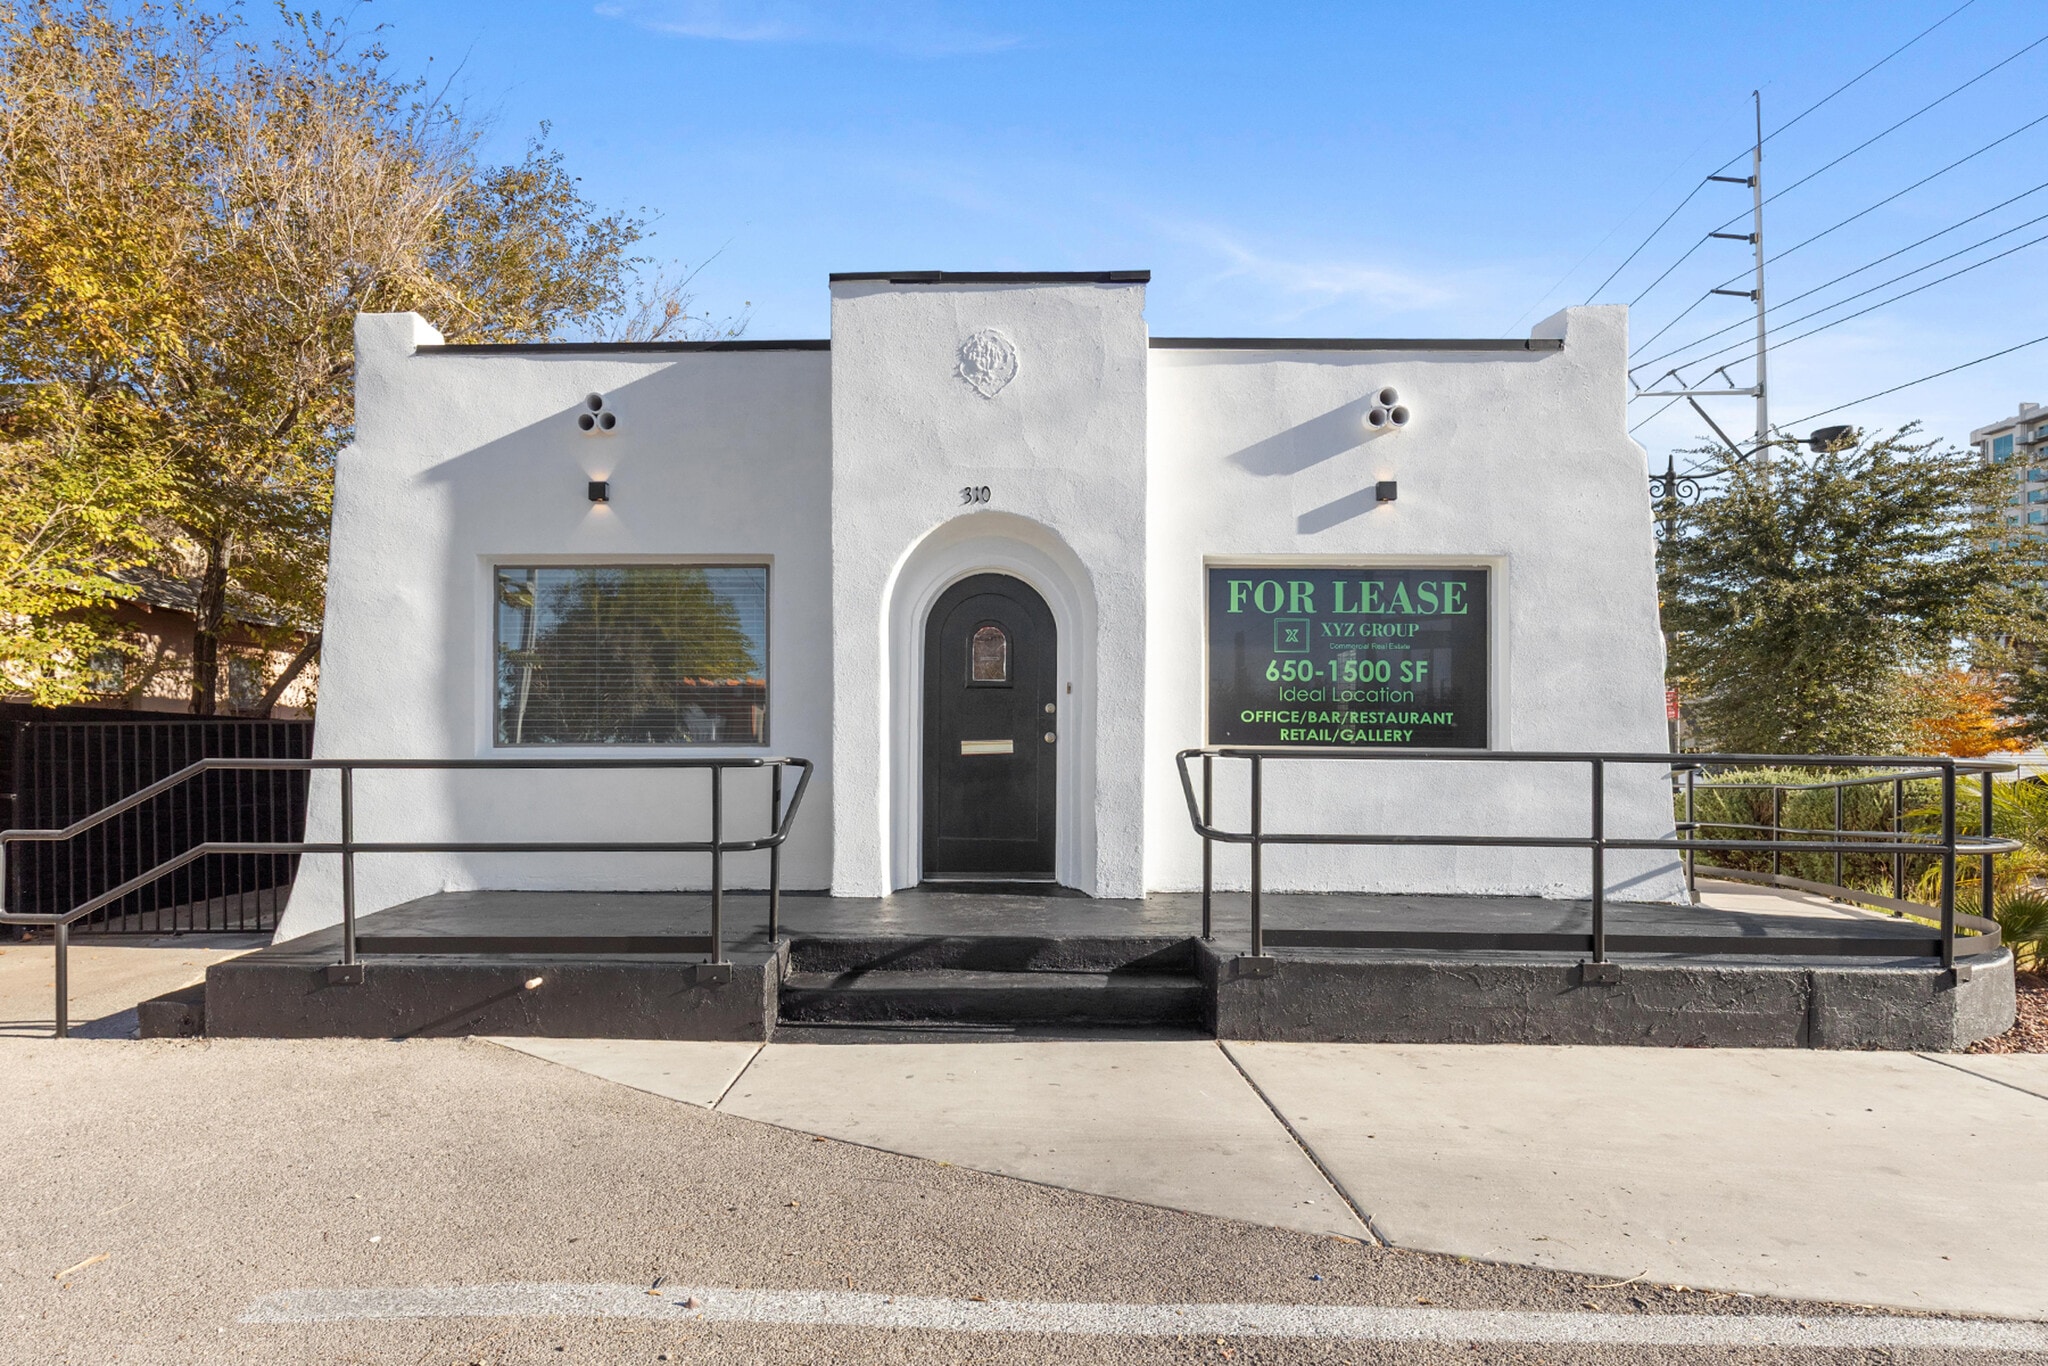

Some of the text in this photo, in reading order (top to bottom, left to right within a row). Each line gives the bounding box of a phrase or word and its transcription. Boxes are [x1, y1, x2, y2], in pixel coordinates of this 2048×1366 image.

[962, 486, 991, 504] 310
[1227, 580, 1468, 615] FOR LEASE
[1321, 622, 1419, 638] XYZ GROUP
[1371, 642, 1387, 650] Real
[1389, 642, 1411, 650] Estate
[1265, 660, 1428, 683] 650-1500 SF
[1279, 686, 1414, 703] Ideal Location
[1240, 710, 1453, 725] OFFICE/BAR/RESTAURANT
[1280, 728, 1413, 743] RETAIL/GALLERY
